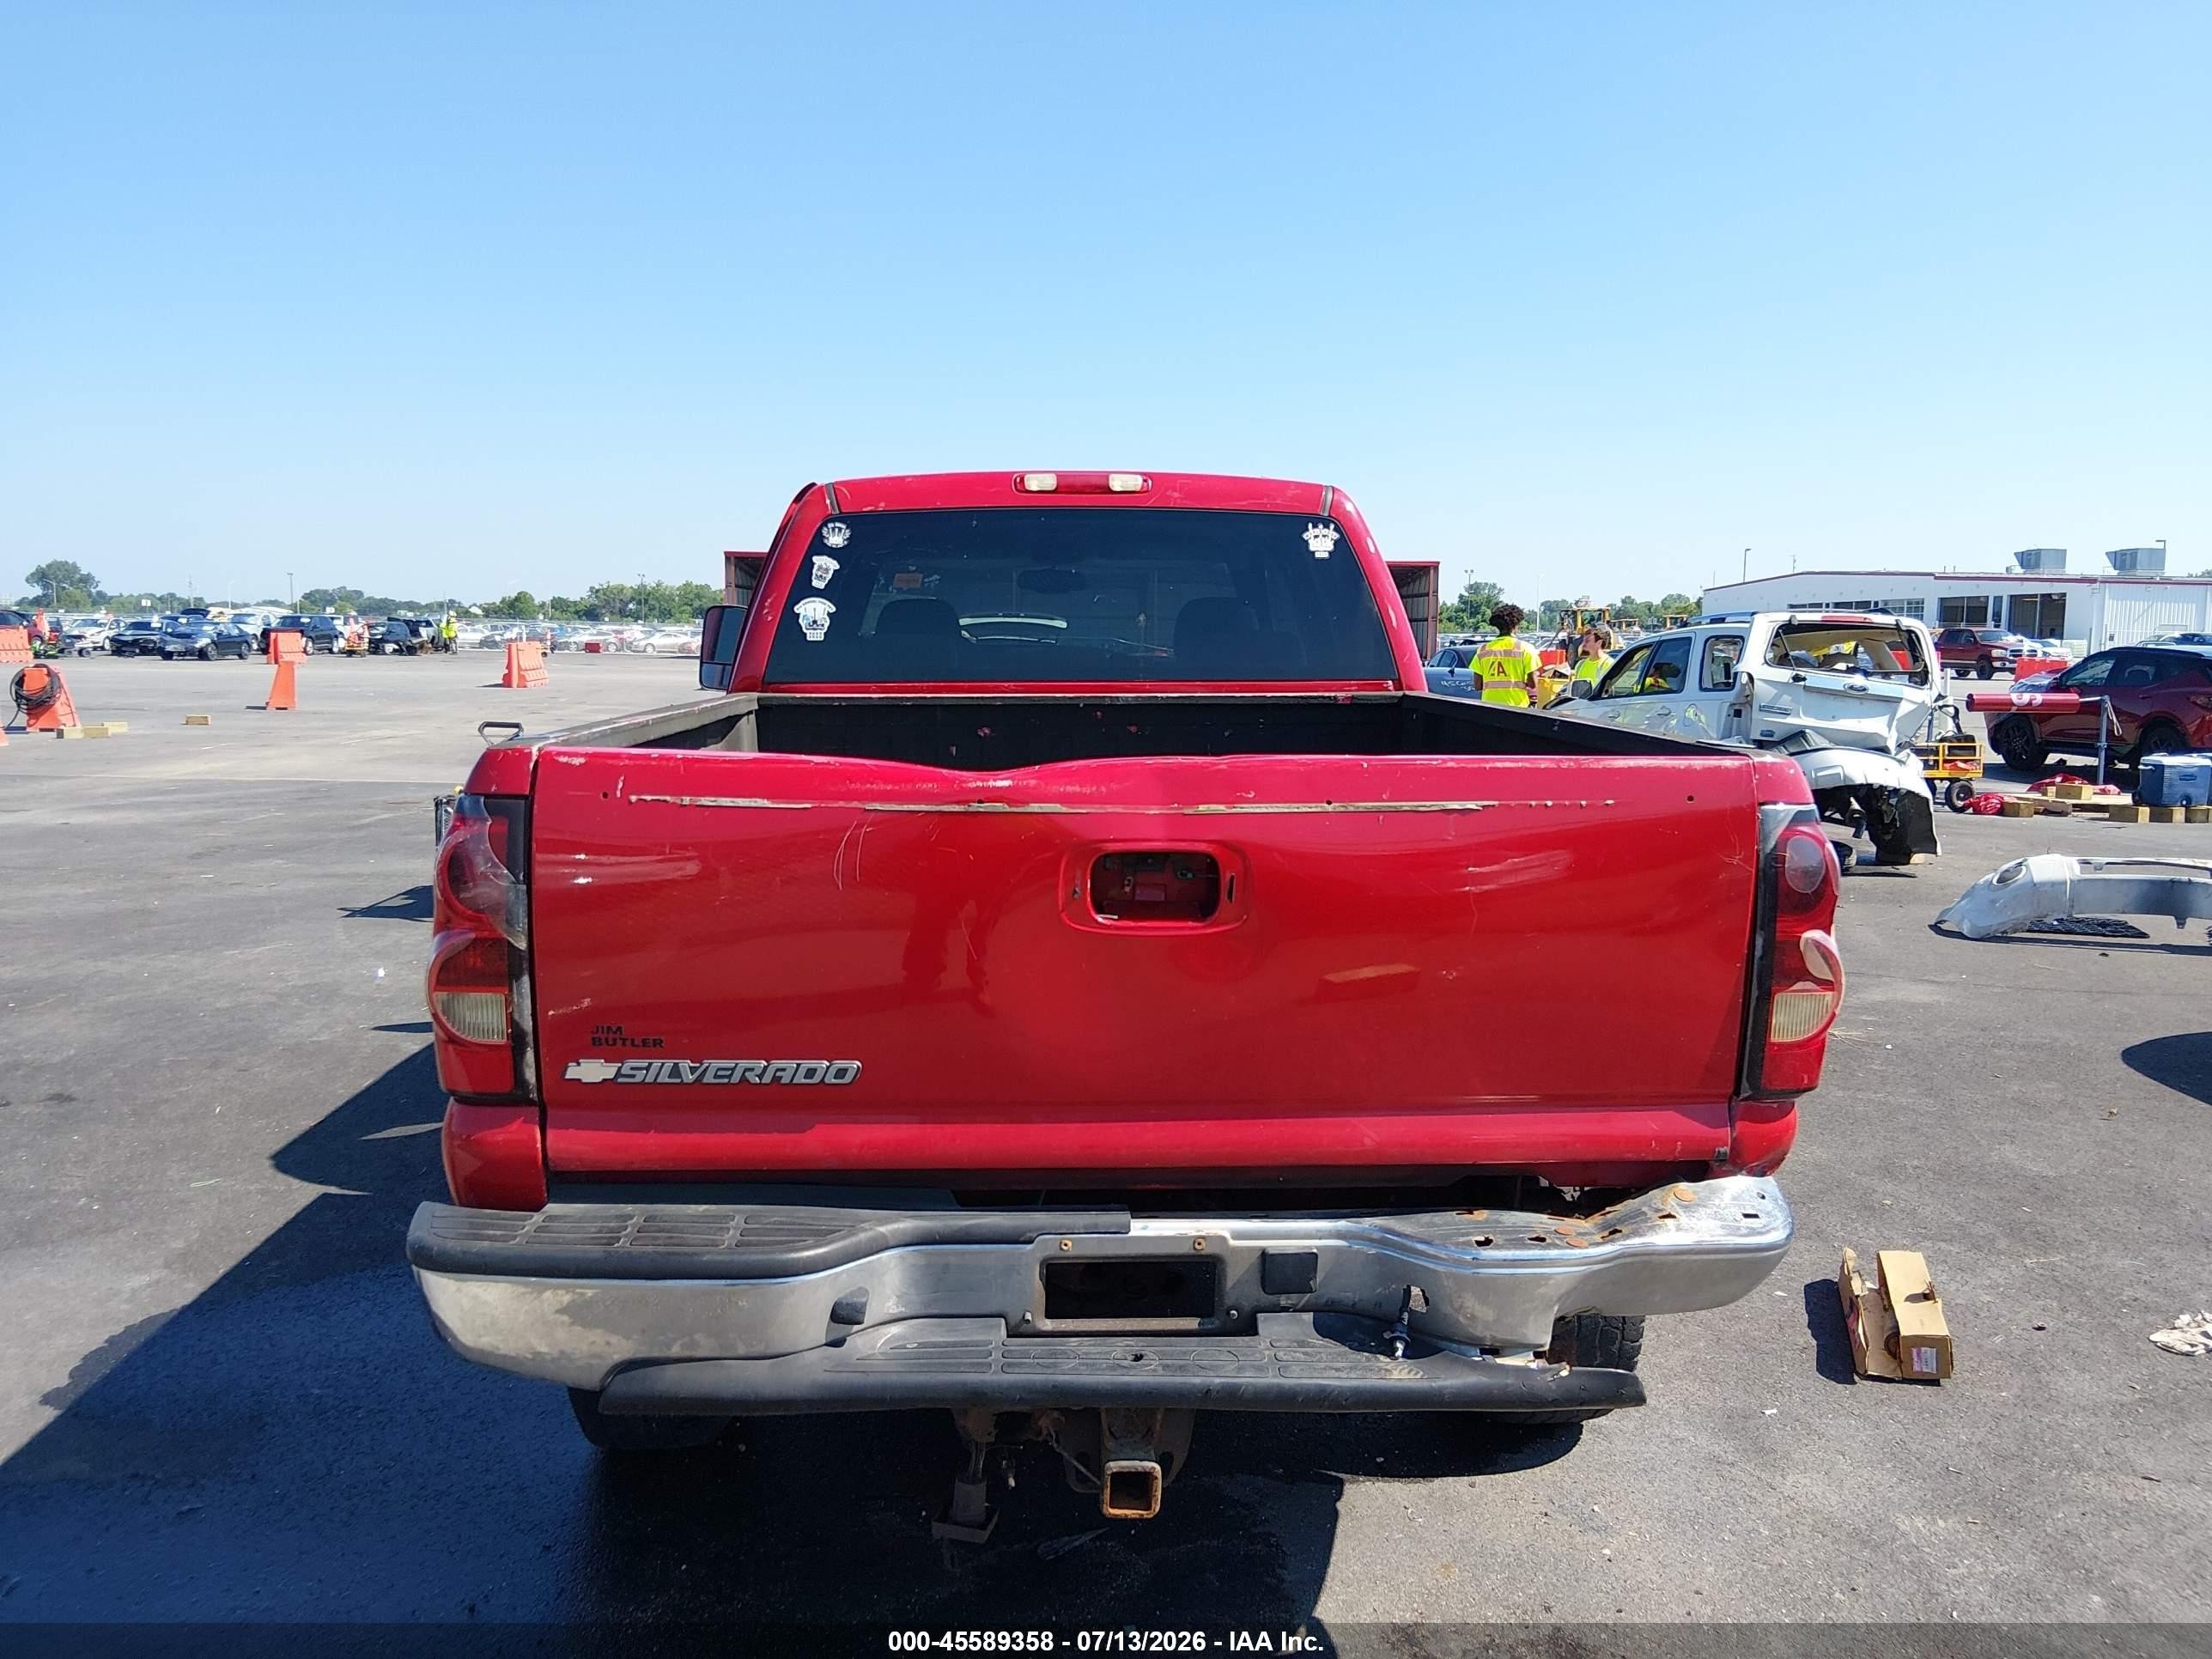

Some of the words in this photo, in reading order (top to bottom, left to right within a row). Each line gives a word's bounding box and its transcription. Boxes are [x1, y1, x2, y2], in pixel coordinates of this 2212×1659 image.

[591, 1024, 624, 1036] JIM
[591, 1036, 665, 1048] BUTLER
[616, 1060, 862, 1085] SILVERADO
